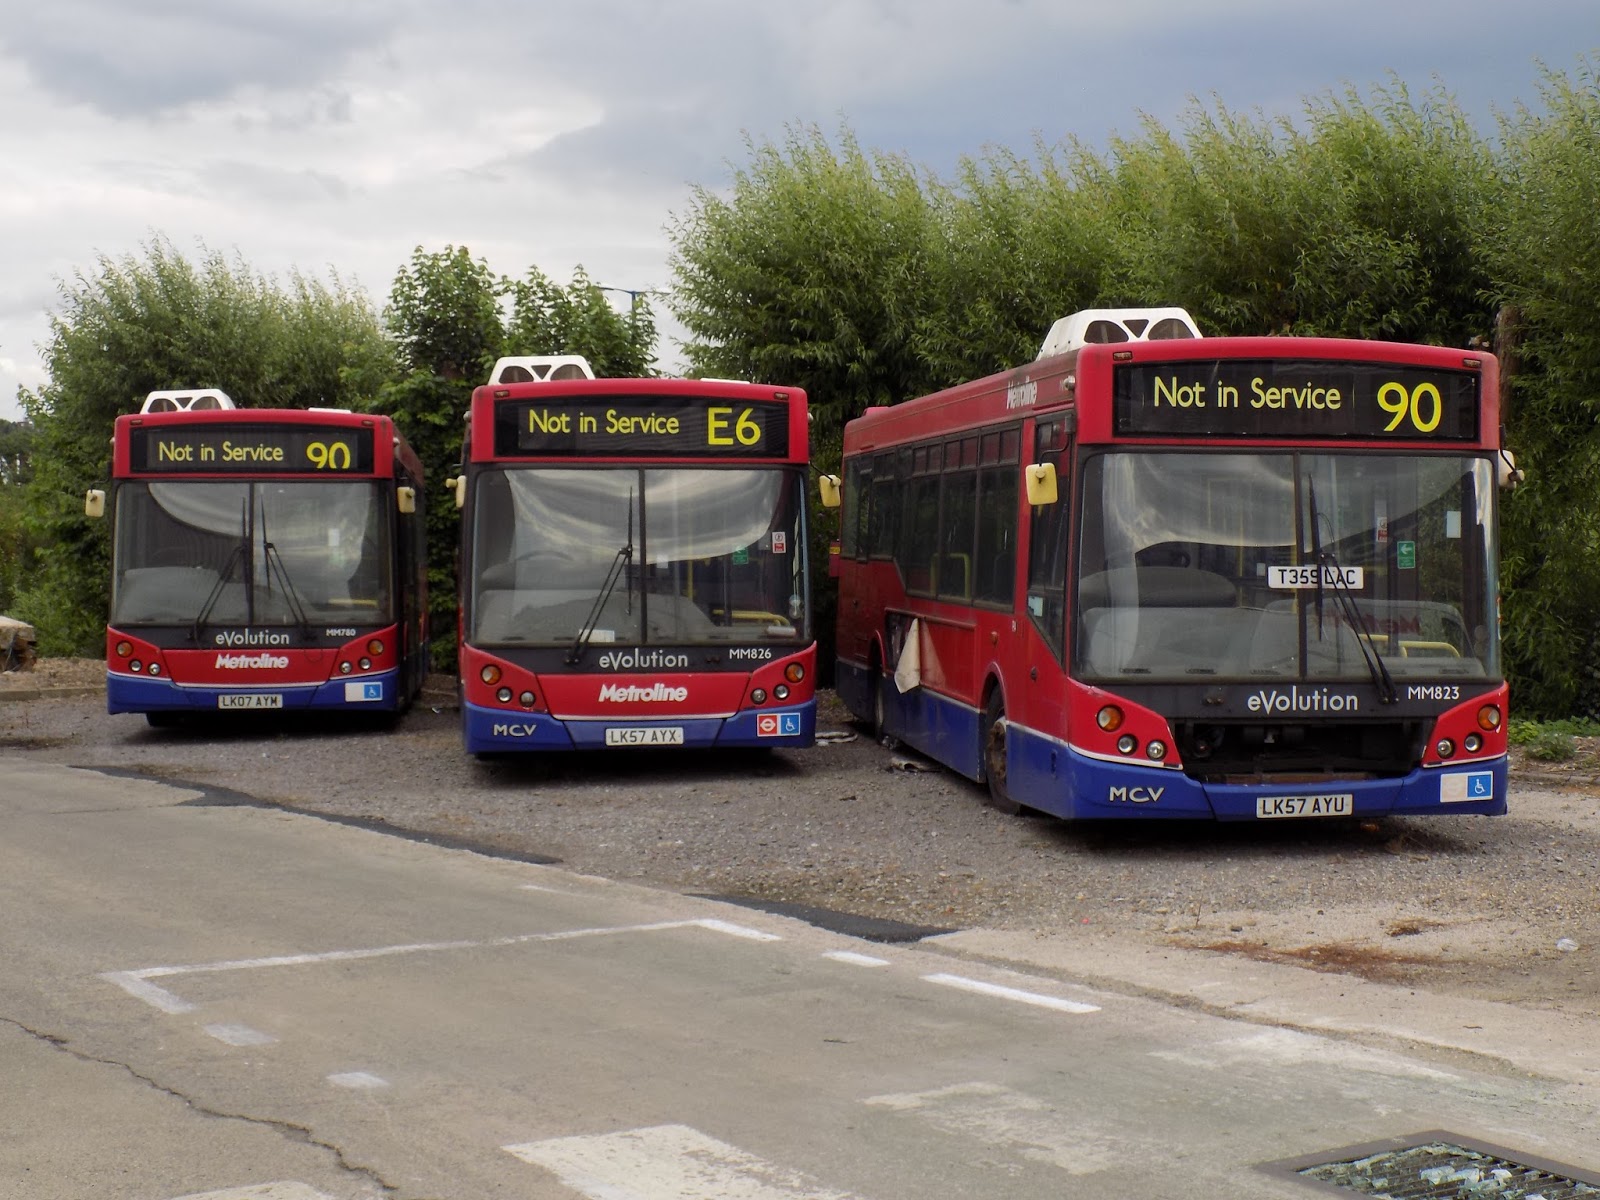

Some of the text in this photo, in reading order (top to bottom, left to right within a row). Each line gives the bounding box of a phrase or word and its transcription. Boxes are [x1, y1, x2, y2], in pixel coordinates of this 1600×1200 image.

[1154, 376, 1342, 410] Not in Service
[1377, 381, 1442, 433] 90
[529, 409, 680, 434] Not in Service
[708, 407, 762, 446] E6
[158, 441, 284, 462] Not in Service
[306, 442, 351, 469] 90
[1324, 569, 1356, 585] LAC
[215, 628, 290, 647] eVolution
[326, 628, 357, 637] MM780
[215, 653, 289, 669] Metroline
[599, 648, 688, 671] eVolution
[729, 649, 772, 660] MM826
[222, 696, 279, 707] LK07 AYM
[598, 683, 688, 703] Metroline
[1247, 685, 1358, 715] eVolution
[1407, 686, 1460, 700] MM823
[493, 724, 537, 737] MCV
[610, 730, 677, 744] LK57 AYX
[1108, 786, 1165, 803] MCV
[1262, 797, 1345, 815] LK57 AYU
